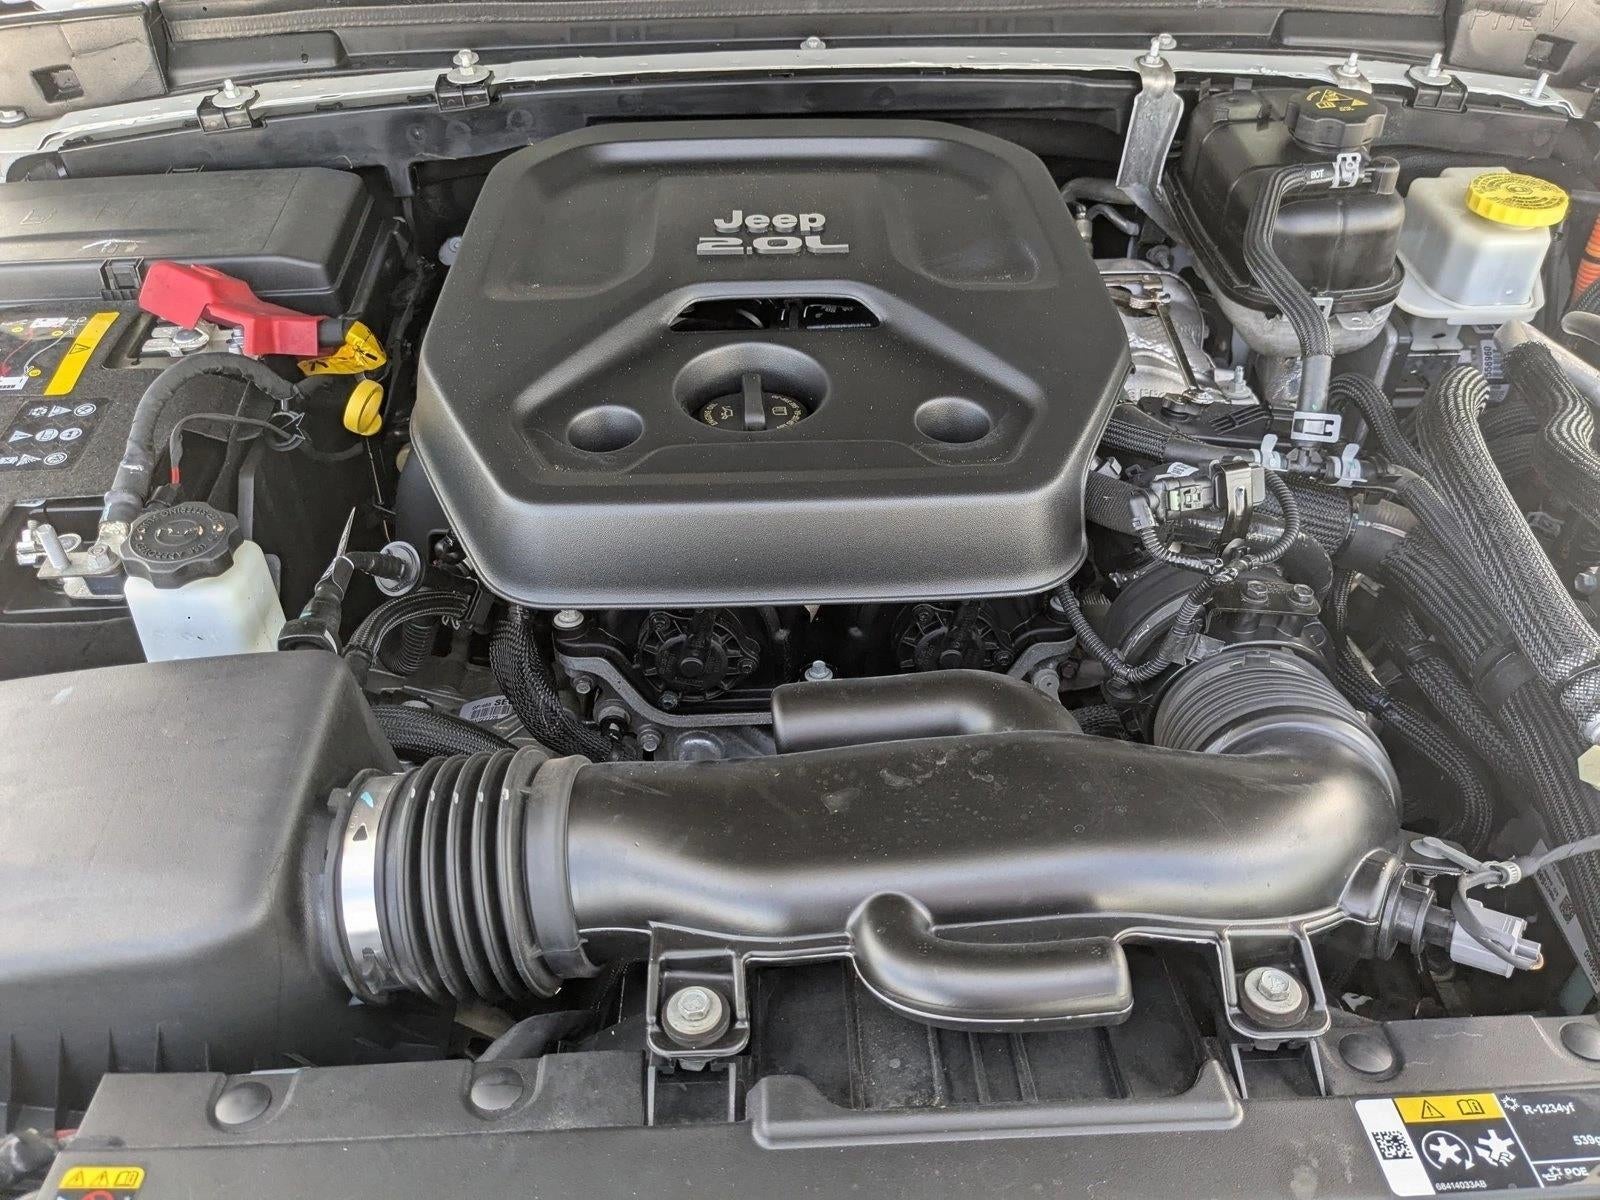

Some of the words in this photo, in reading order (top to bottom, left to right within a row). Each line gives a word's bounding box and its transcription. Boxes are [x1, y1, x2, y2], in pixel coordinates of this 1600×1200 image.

[713, 210, 826, 235] Jeep
[697, 235, 849, 255] 2.0L
[1522, 1102, 1577, 1115] R-1234yf
[1564, 1166, 1590, 1178] POE
[1435, 1180, 1488, 1191] 68414033AB
